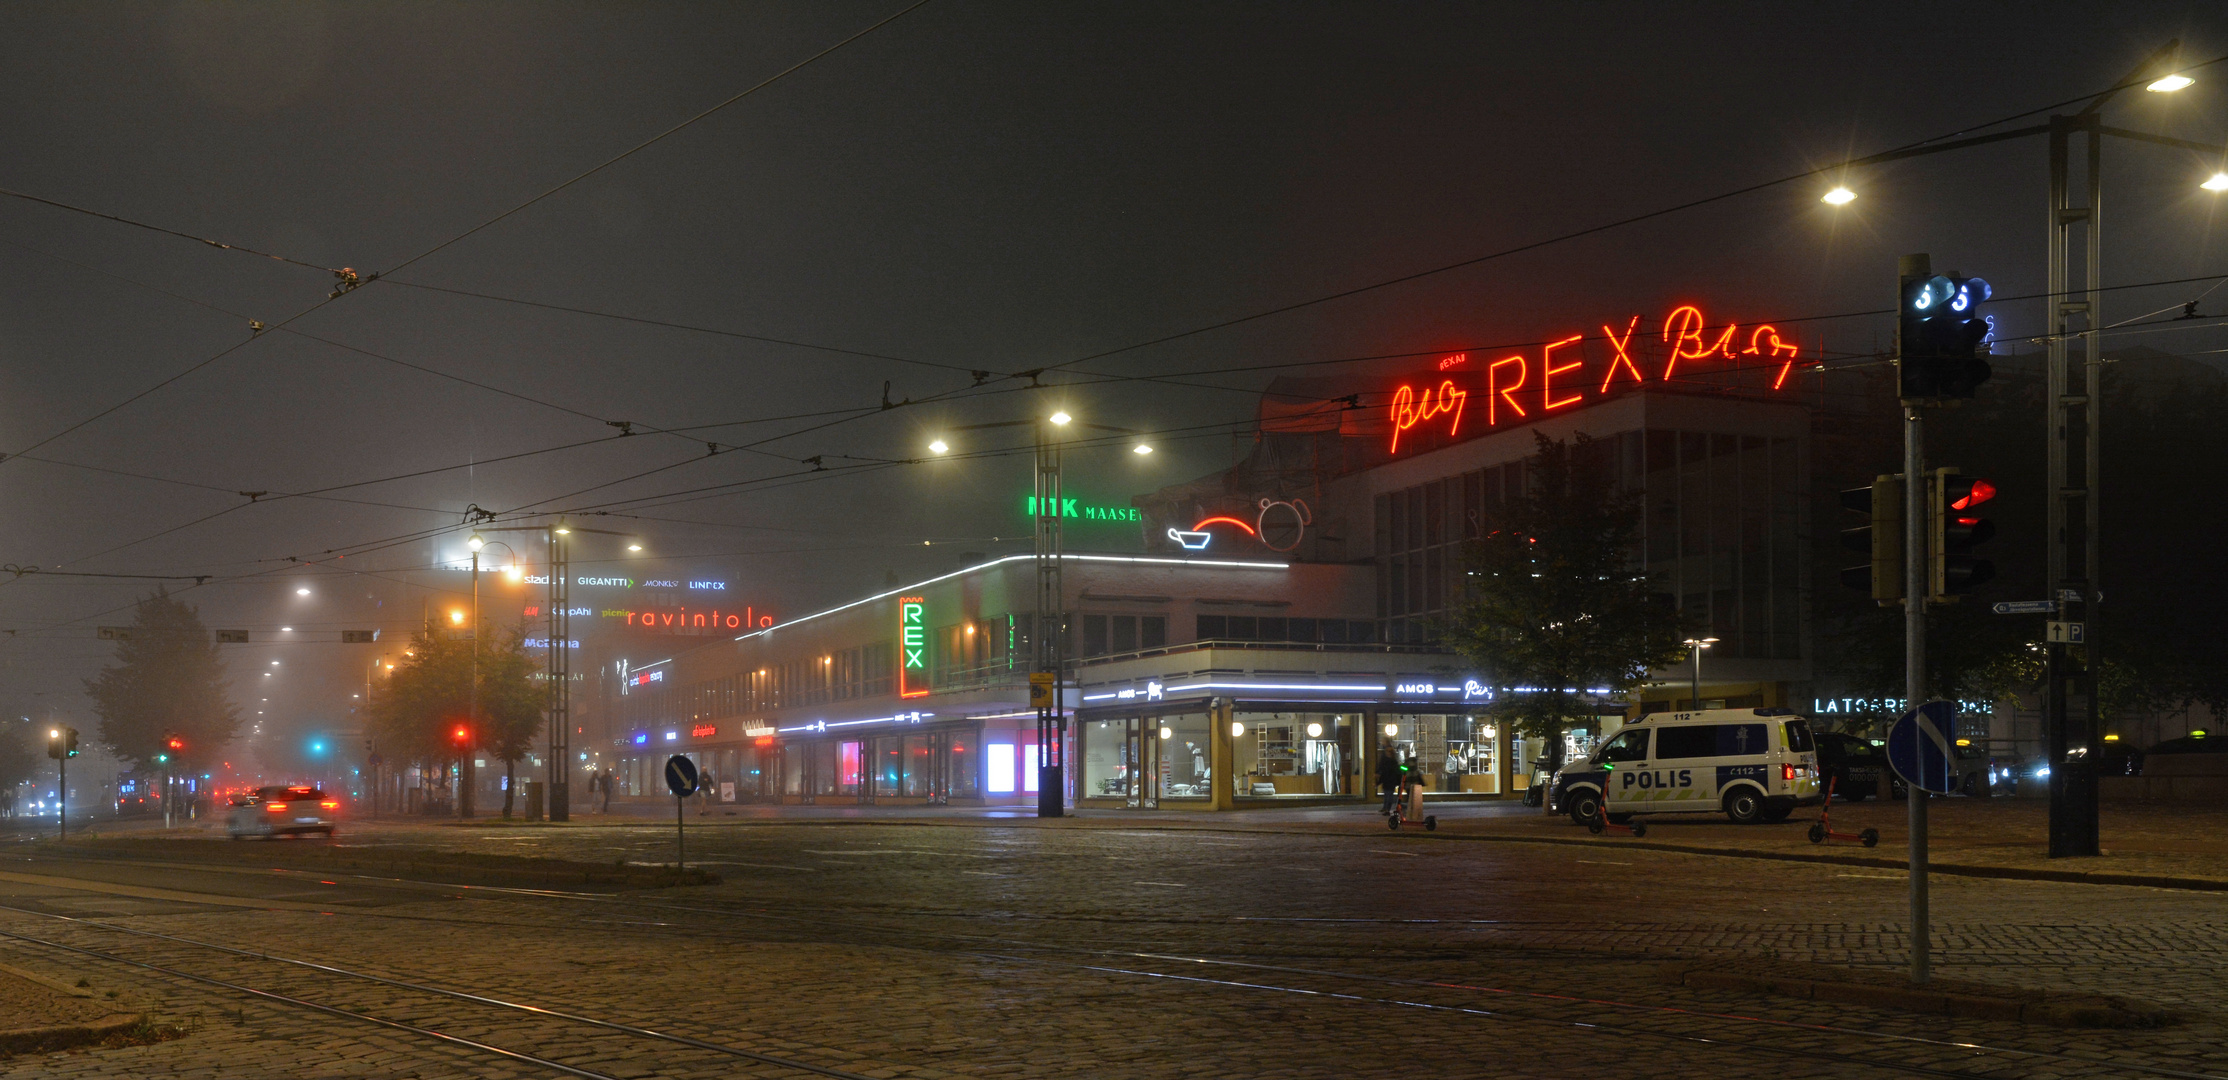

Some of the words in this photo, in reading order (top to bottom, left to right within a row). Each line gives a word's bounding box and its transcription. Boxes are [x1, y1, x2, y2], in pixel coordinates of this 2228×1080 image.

[1490, 315, 1642, 425] REX
[1086, 507, 1142, 522] MAASE
[577, 577, 628, 587] GIGANTTI
[689, 581, 726, 590] LINDEX
[627, 606, 773, 628] ravintola
[903, 603, 924, 668] REX
[1396, 683, 1434, 694] AMOS
[1673, 713, 1691, 721] 112
[1736, 766, 1754, 776] 112
[1622, 769, 1692, 790] POLIS
